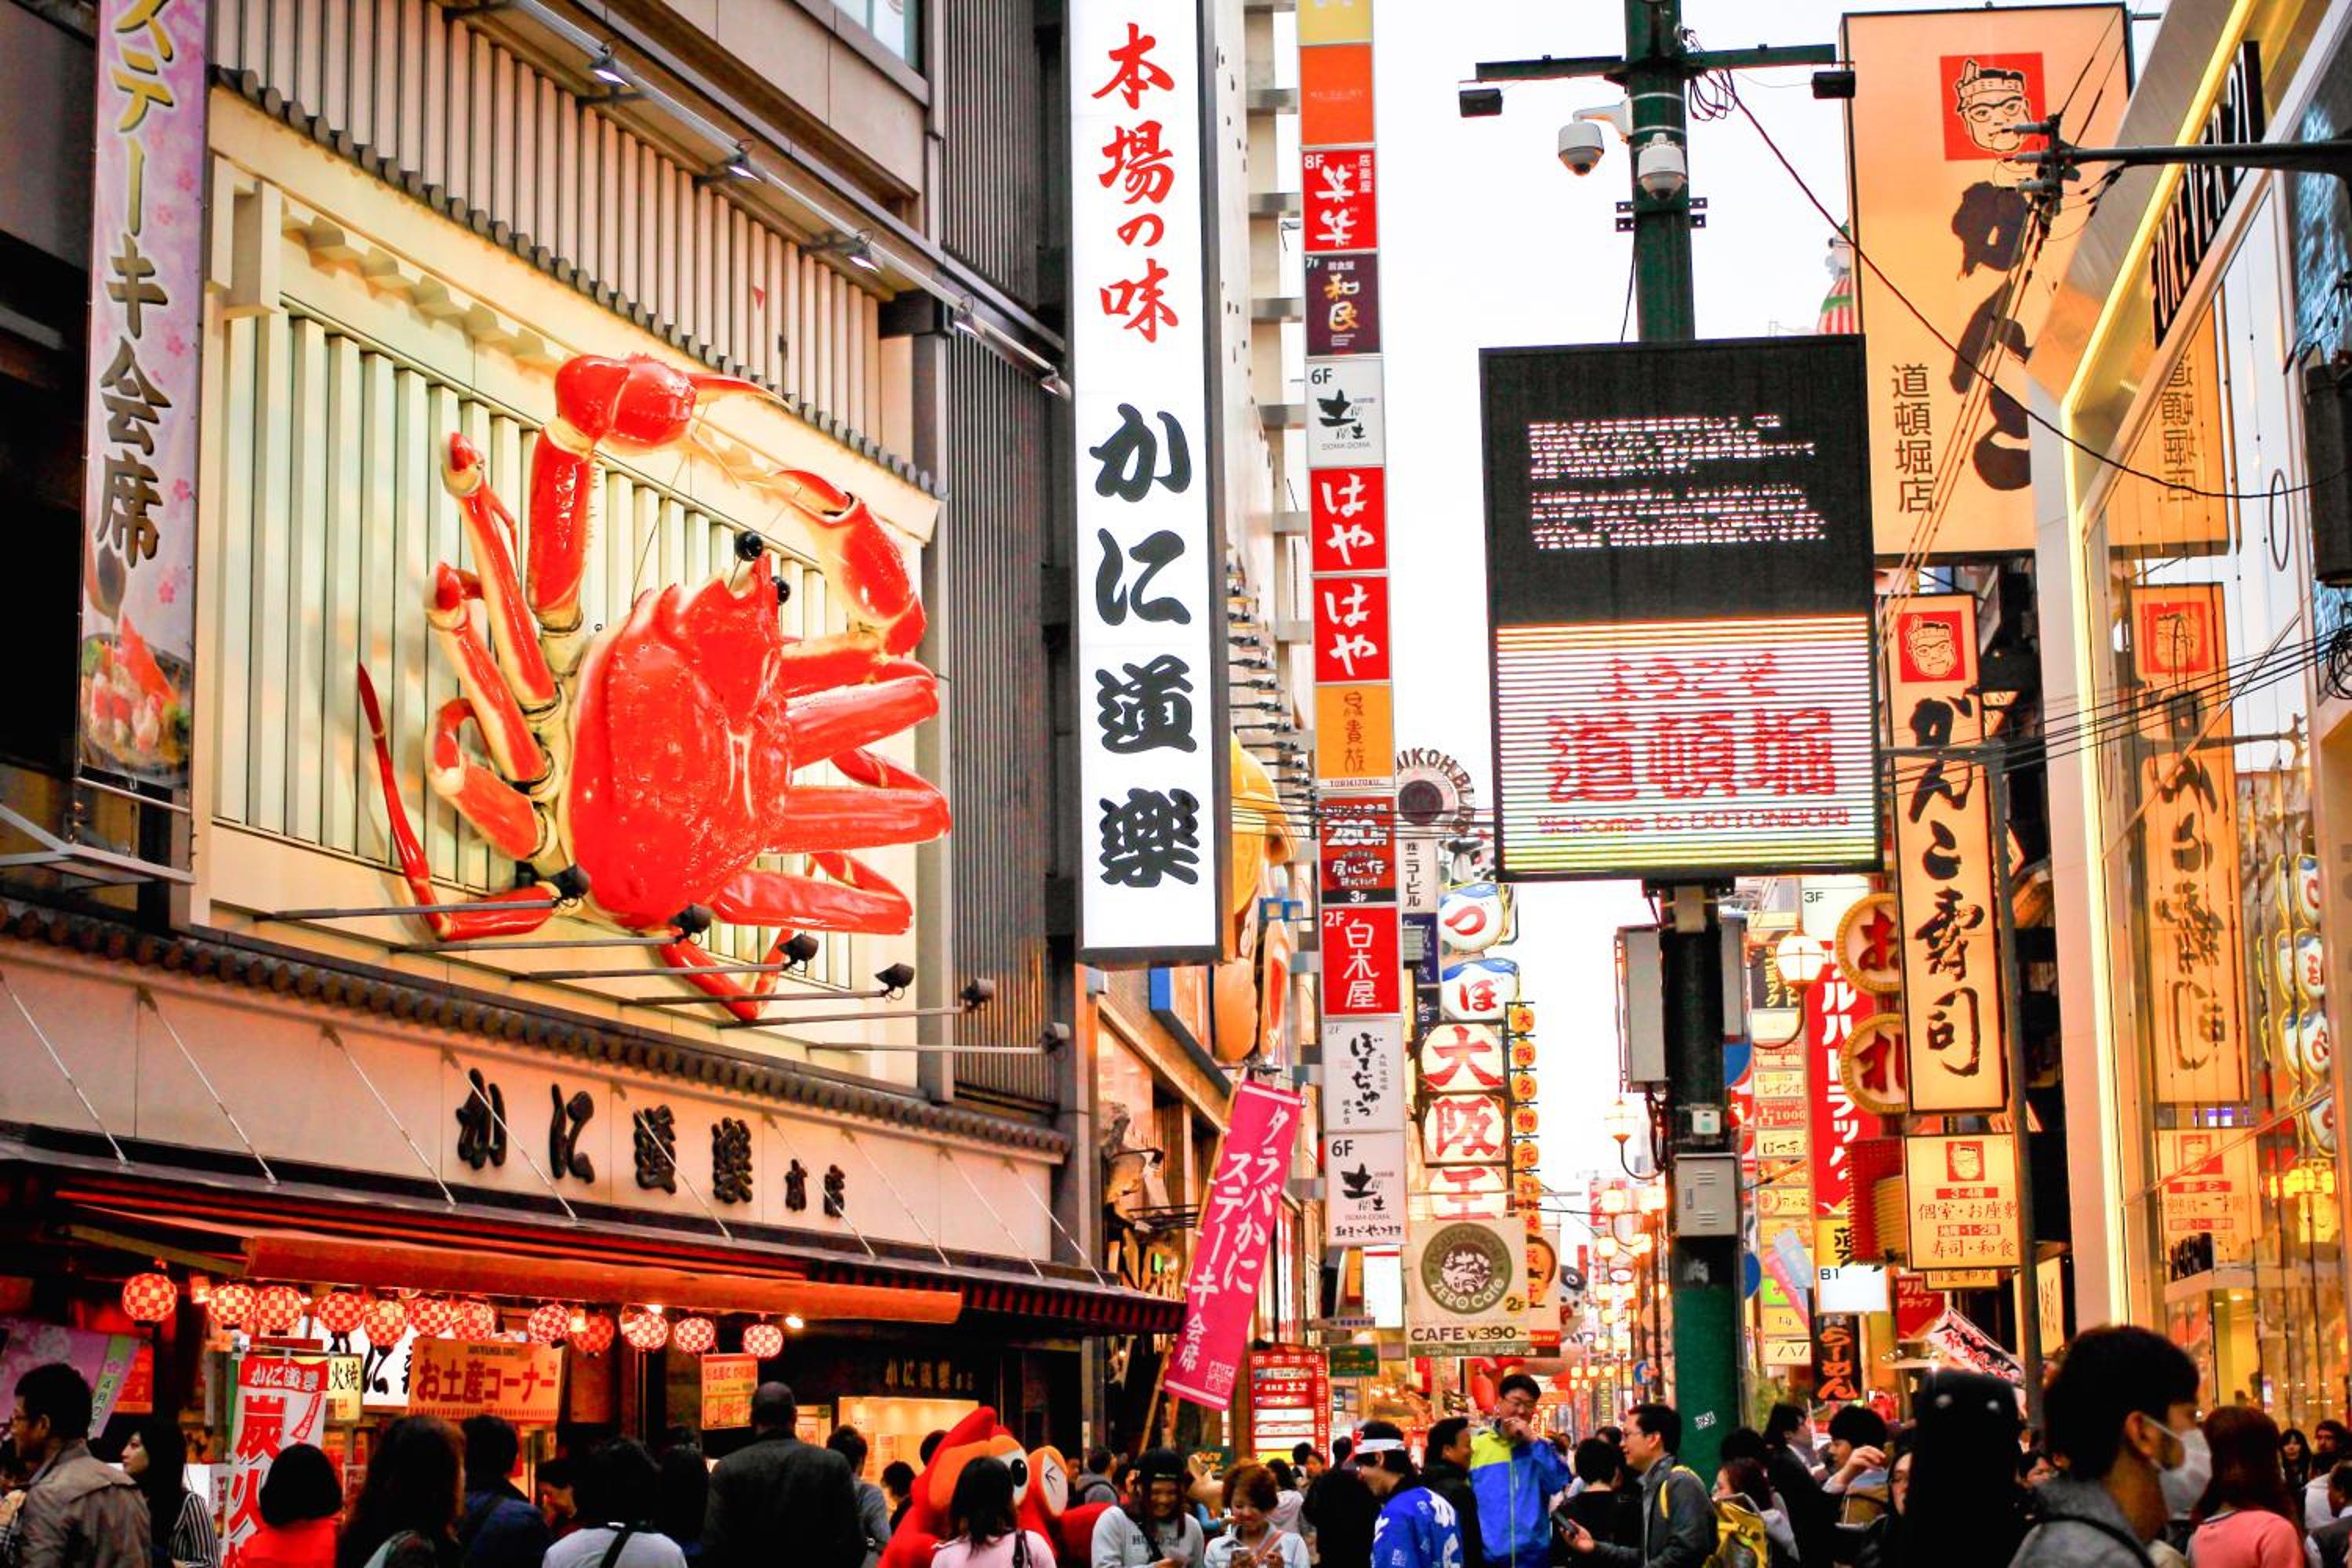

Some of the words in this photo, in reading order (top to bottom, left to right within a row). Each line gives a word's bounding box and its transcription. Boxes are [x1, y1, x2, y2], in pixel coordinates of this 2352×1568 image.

[1304, 154, 1324, 169] 8F
[1091, 22, 1179, 343] 本場の味
[1311, 368, 1333, 385] 6F
[1892, 363, 1934, 514] 道頓堀店
[1321, 473, 1376, 566] はや
[1324, 583, 1378, 677] はや
[1598, 652, 1780, 702] ようこそ
[1546, 707, 1835, 804] 道頓堀
[1537, 814, 1645, 834] Welcome
[1655, 814, 1683, 830] to
[1349, 890, 1367, 903] 3F
[1804, 892, 1825, 903] 3F
[1324, 911, 1345, 927] 2F
[1342, 918, 1381, 1009] 白木屋
[1331, 1139, 1354, 1157] 6F
[1223, 1104, 1290, 1294] タラバかに
[1178, 1152, 1252, 1373] ステーキ会席
[1429, 1278, 1470, 1310] ZERO
[1505, 1297, 1526, 1312] 2F
[1411, 1326, 1465, 1342] CAFE
[327, 1361, 359, 1391] 火焼
[416, 1358, 556, 1404] お土産コーナー
[221, 1395, 287, 1568] 炭火
